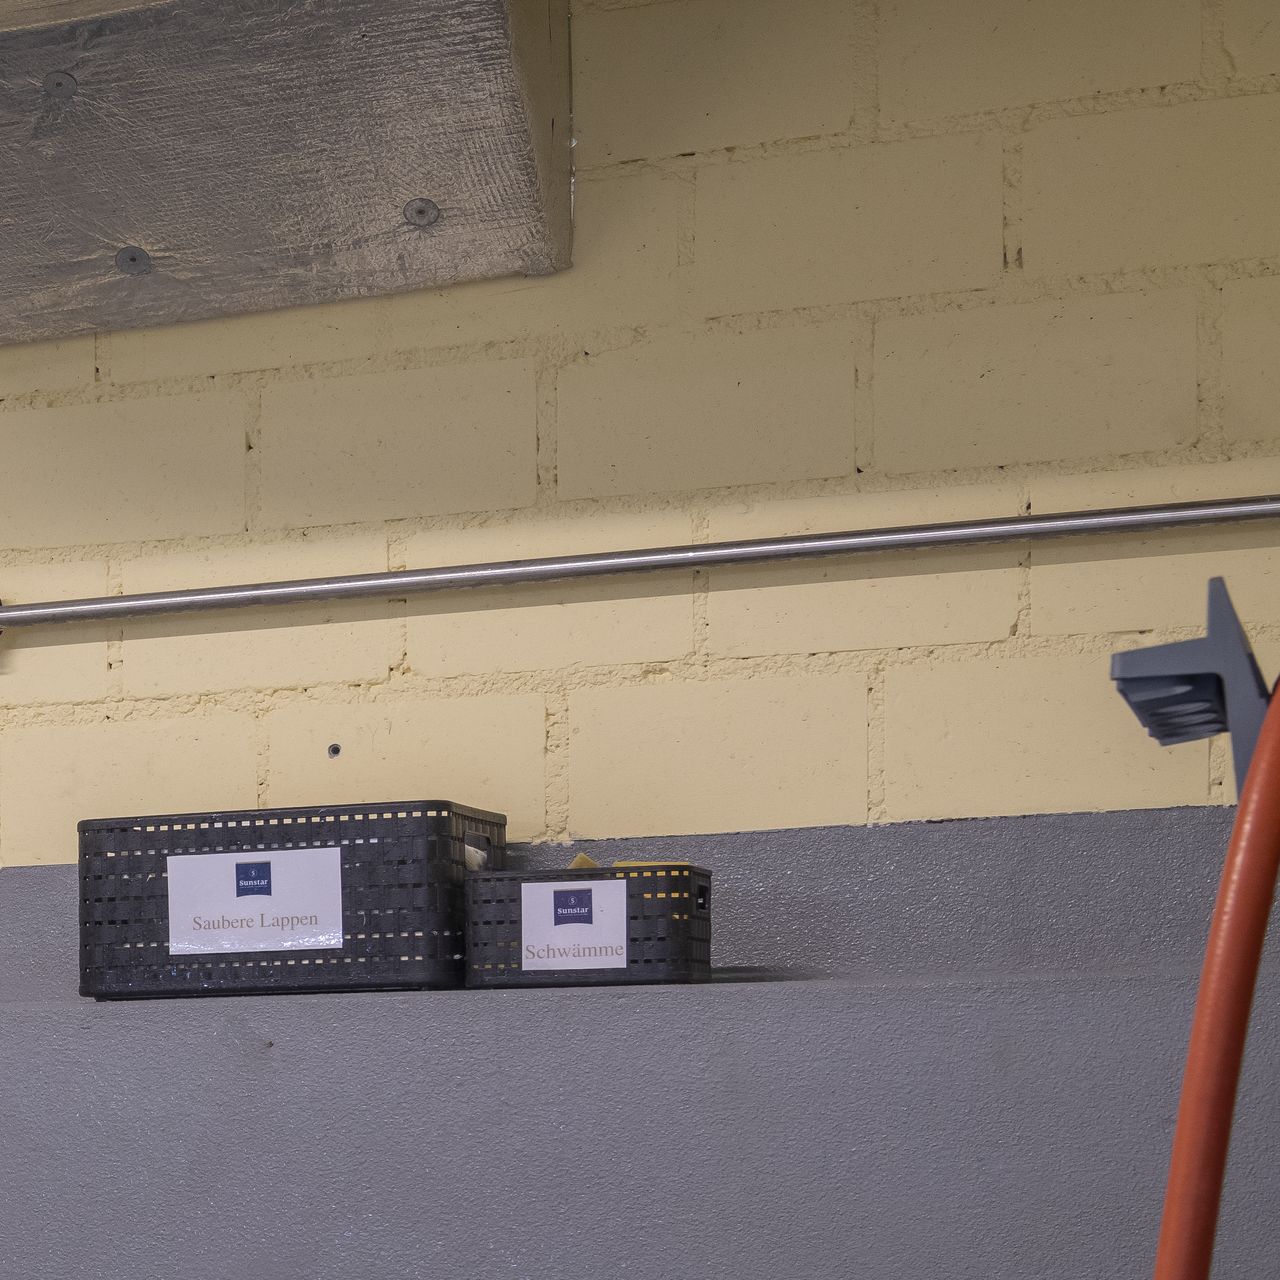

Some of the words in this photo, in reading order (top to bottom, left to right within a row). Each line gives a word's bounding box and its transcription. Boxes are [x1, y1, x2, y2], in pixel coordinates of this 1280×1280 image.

[239, 878, 269, 887] Sunstar
[557, 906, 589, 915] Sunstar
[192, 914, 255, 931] Saubere
[260, 913, 318, 931] Lappen
[525, 943, 624, 960] Schwämme
